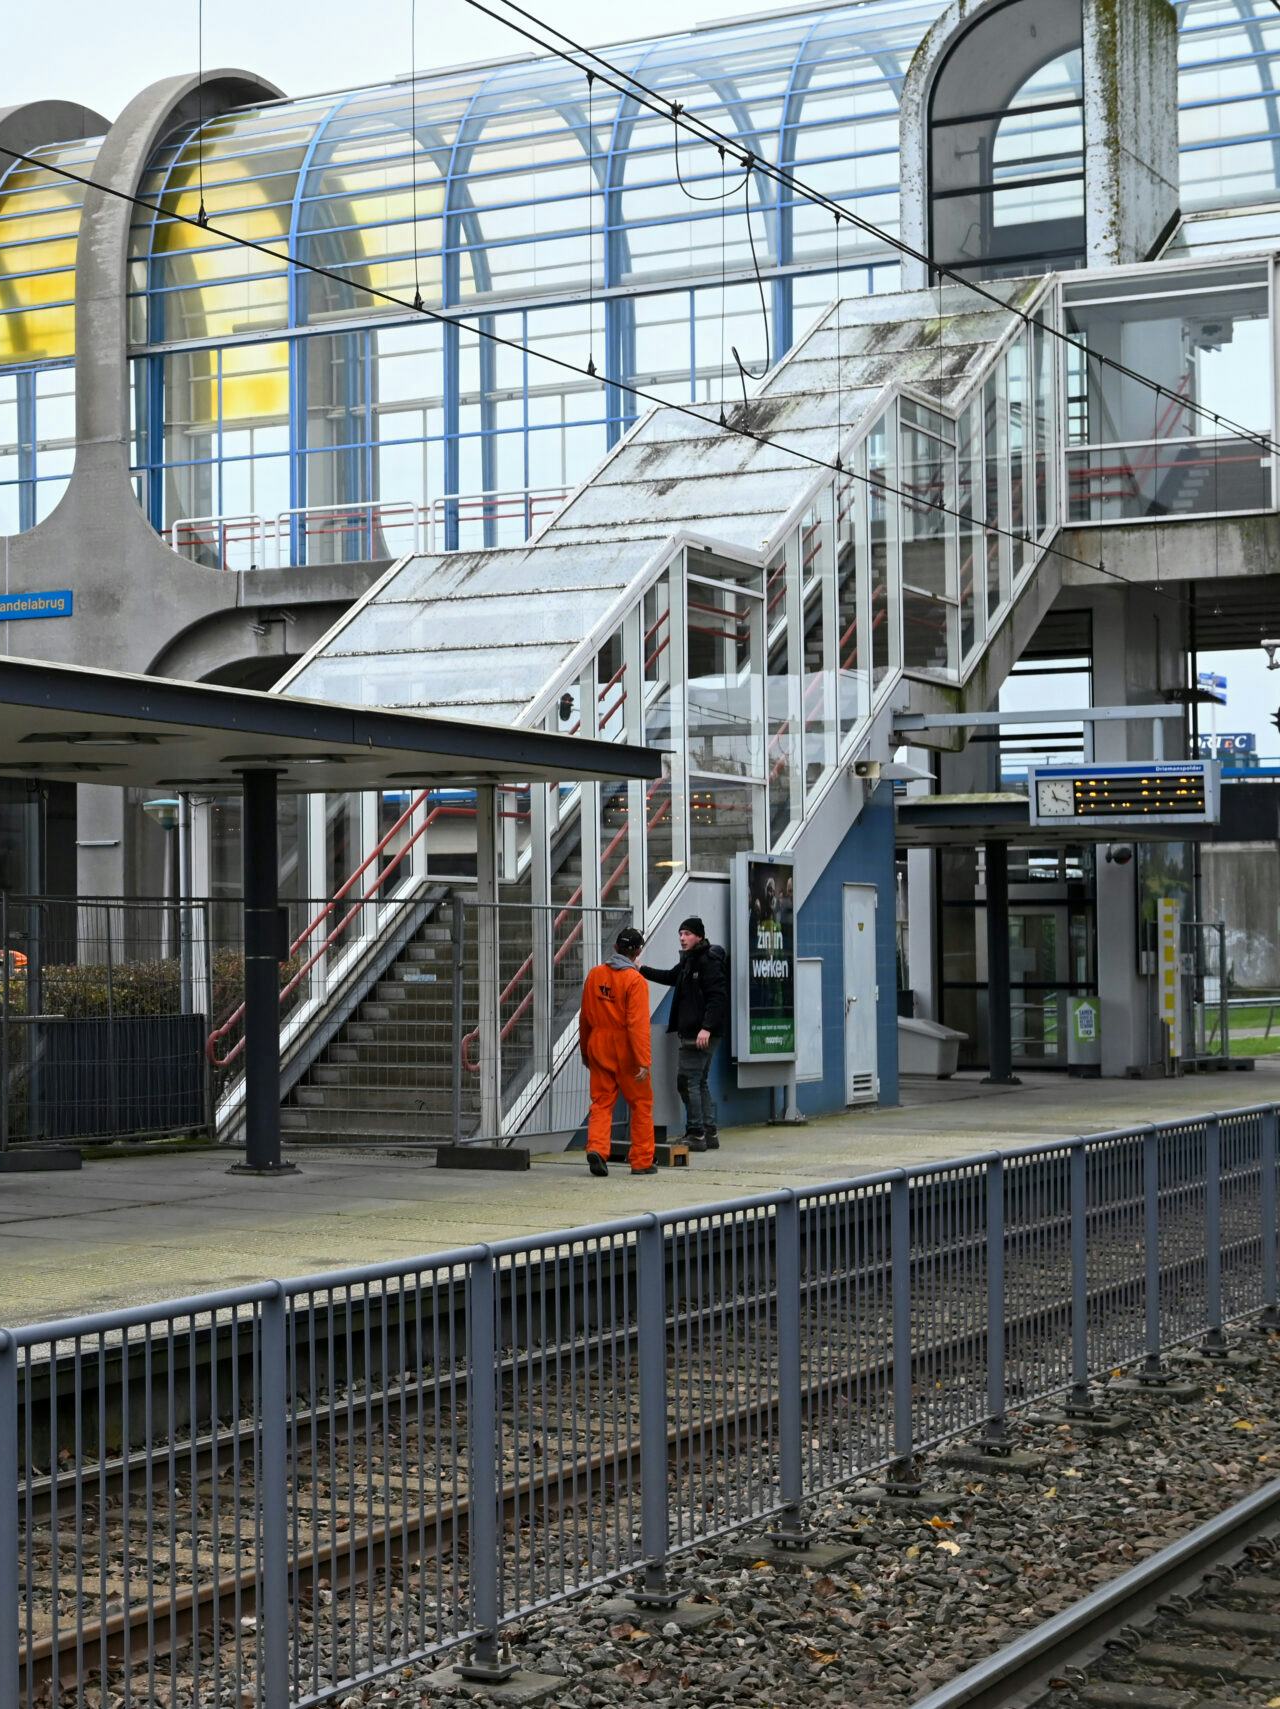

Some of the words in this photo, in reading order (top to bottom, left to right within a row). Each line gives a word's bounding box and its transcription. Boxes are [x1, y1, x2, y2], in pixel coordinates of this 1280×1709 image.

[1155, 765, 1202, 773] Driemanspolder
[757, 925, 771, 949] zin
[773, 926, 783, 949] in
[752, 954, 789, 978] werken
